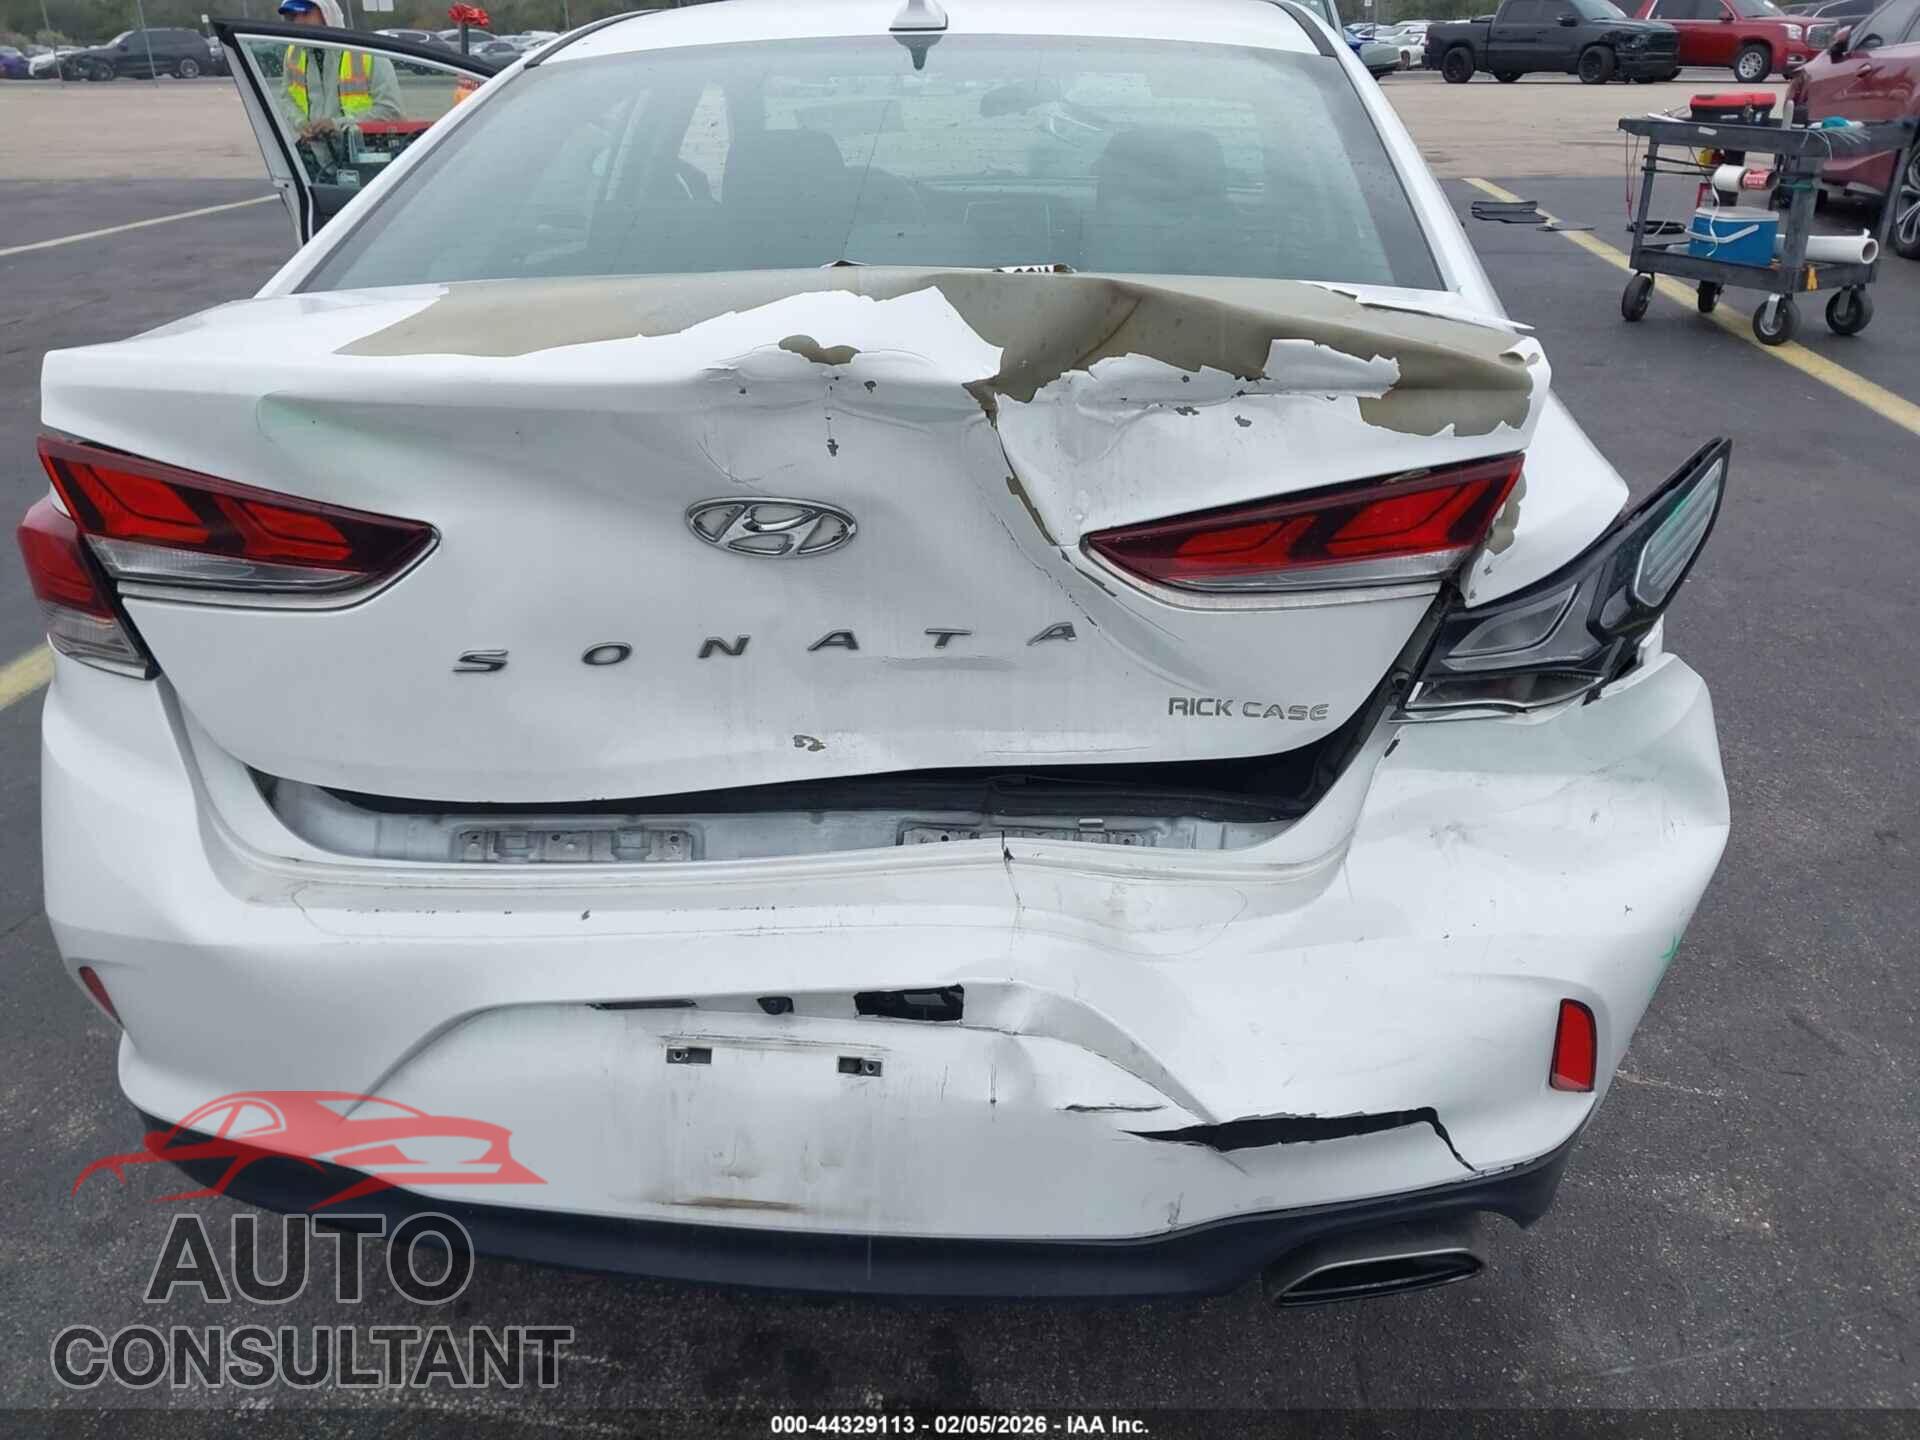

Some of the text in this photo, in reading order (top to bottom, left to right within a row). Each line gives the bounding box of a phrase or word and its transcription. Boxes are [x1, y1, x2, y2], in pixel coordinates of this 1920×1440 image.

[453, 621, 1077, 673] SONATA
[1168, 697, 1330, 721] RICK CASE
